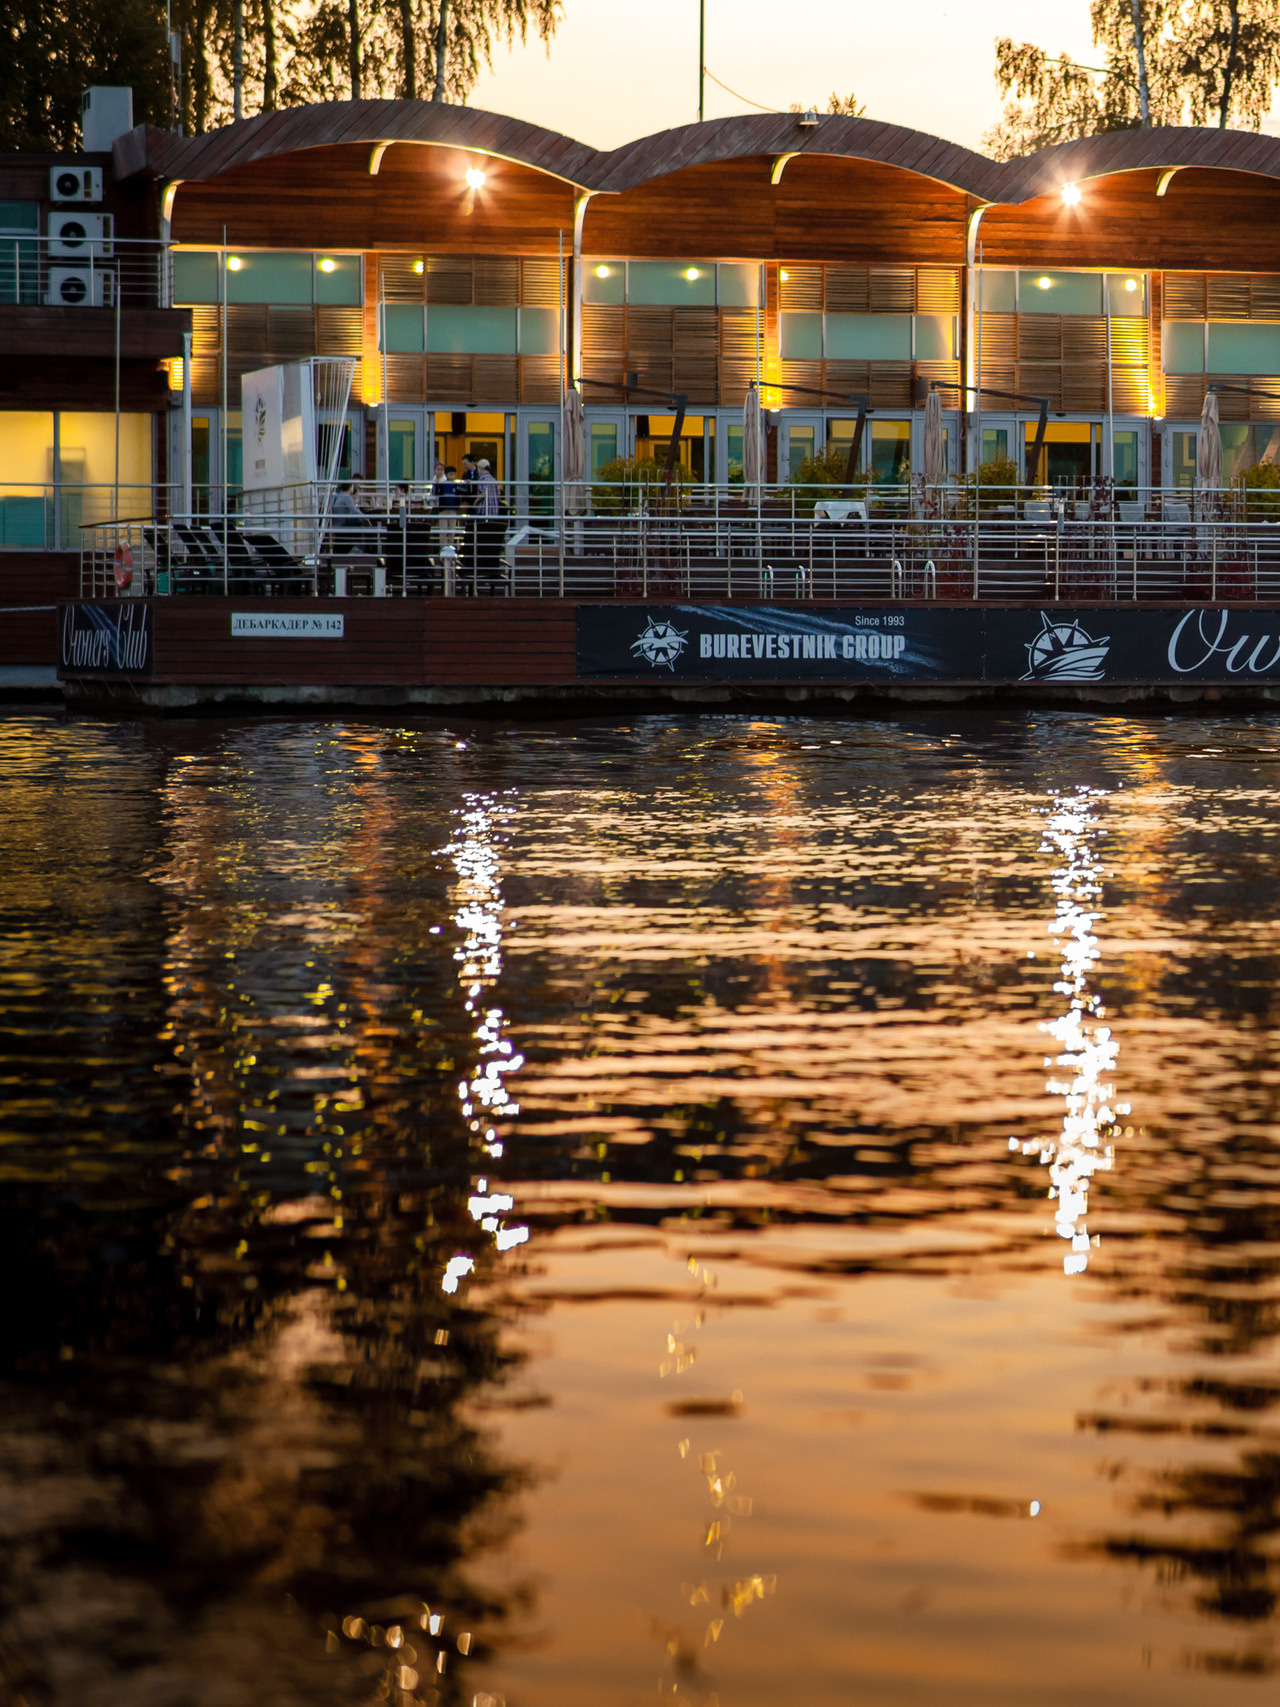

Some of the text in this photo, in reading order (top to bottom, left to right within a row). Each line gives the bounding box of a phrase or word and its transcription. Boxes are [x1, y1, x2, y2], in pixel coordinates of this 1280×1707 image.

[234, 619, 341, 630] ДЕБАРКАДЕР № 142
[855, 615, 904, 626] Since 1993
[117, 604, 147, 668] Club
[700, 634, 905, 659] BUREVESTNIK GROUP
